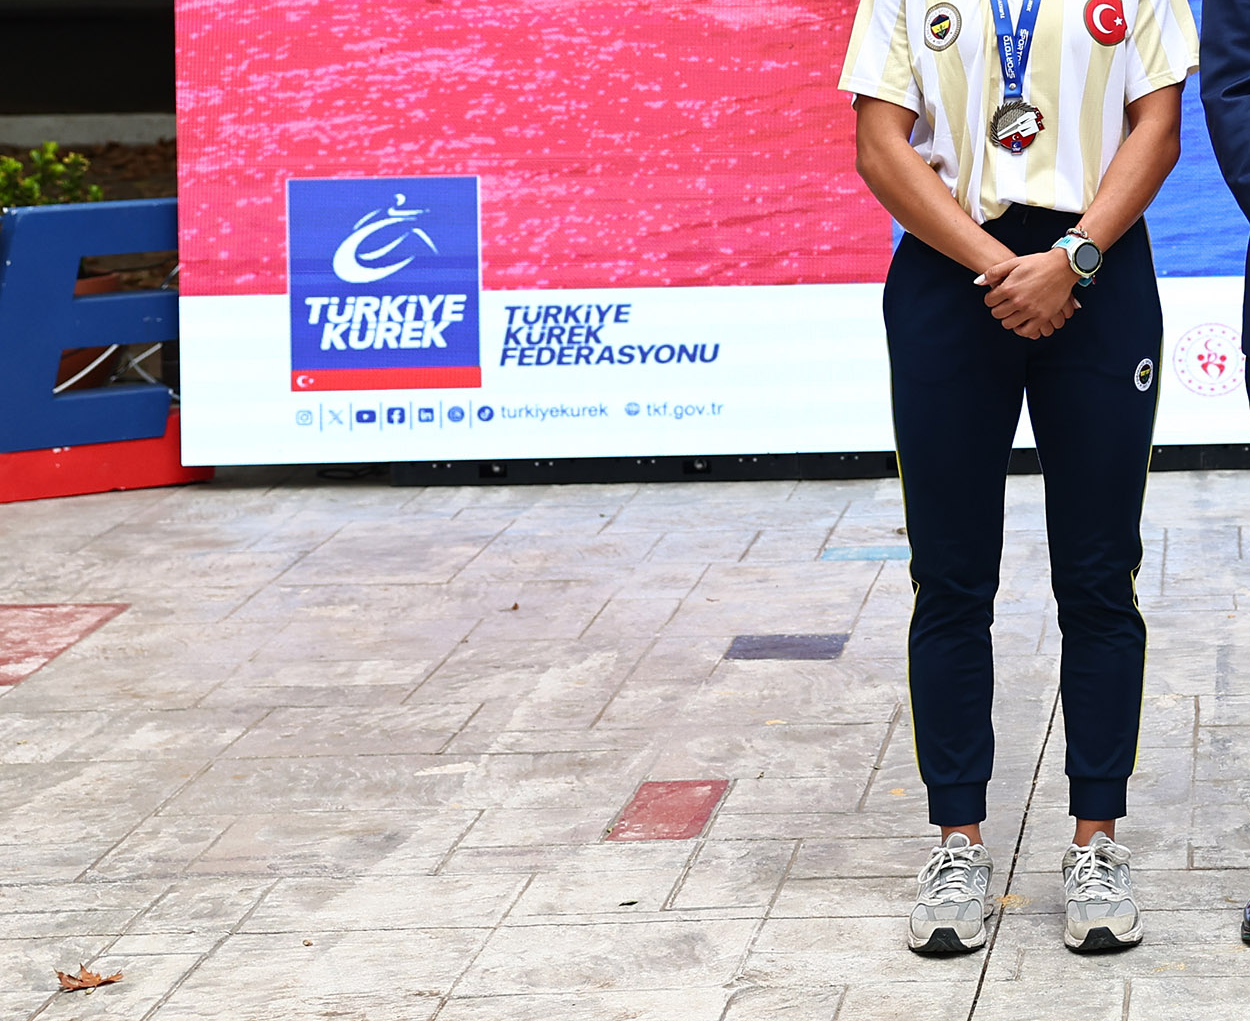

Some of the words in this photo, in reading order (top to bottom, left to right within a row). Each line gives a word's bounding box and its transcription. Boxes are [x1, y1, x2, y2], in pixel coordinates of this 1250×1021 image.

[304, 294, 467, 325] TÜRKİYE
[504, 303, 632, 326] TÜRKİYE
[320, 320, 450, 351] KÜREK
[503, 324, 604, 346] KÜREK
[500, 343, 720, 367] FEDERASYONU
[501, 403, 609, 422] turkiyekurek
[646, 401, 725, 420] tkf.gov.tr
